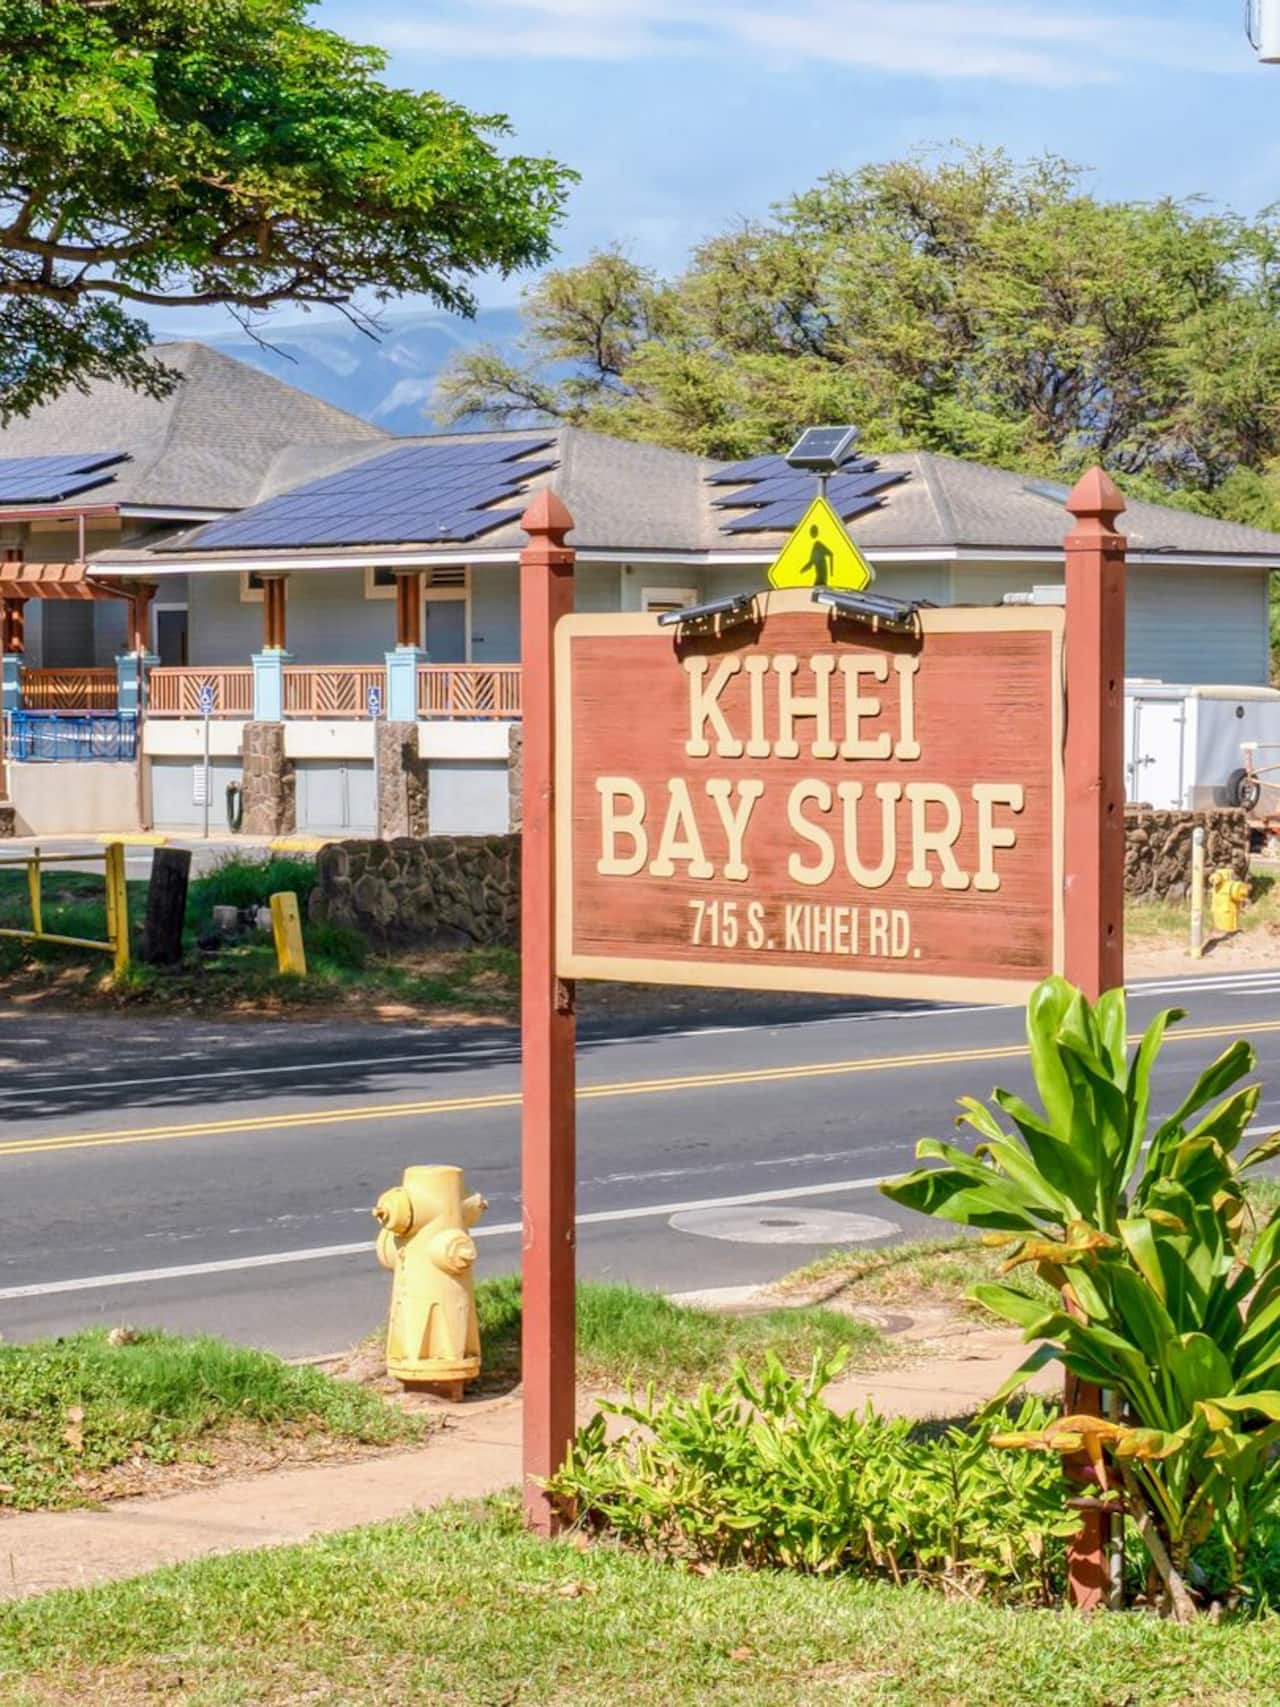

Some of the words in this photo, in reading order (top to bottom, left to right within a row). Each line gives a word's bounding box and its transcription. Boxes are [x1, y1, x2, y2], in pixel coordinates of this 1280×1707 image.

[683, 654, 920, 761] KIHEI
[595, 776, 764, 882] BAY
[786, 778, 1025, 892] SURF
[688, 899, 738, 948] 715
[747, 901, 774, 949] S.
[785, 904, 859, 954] KIHEI
[869, 908, 921, 959] RD.
